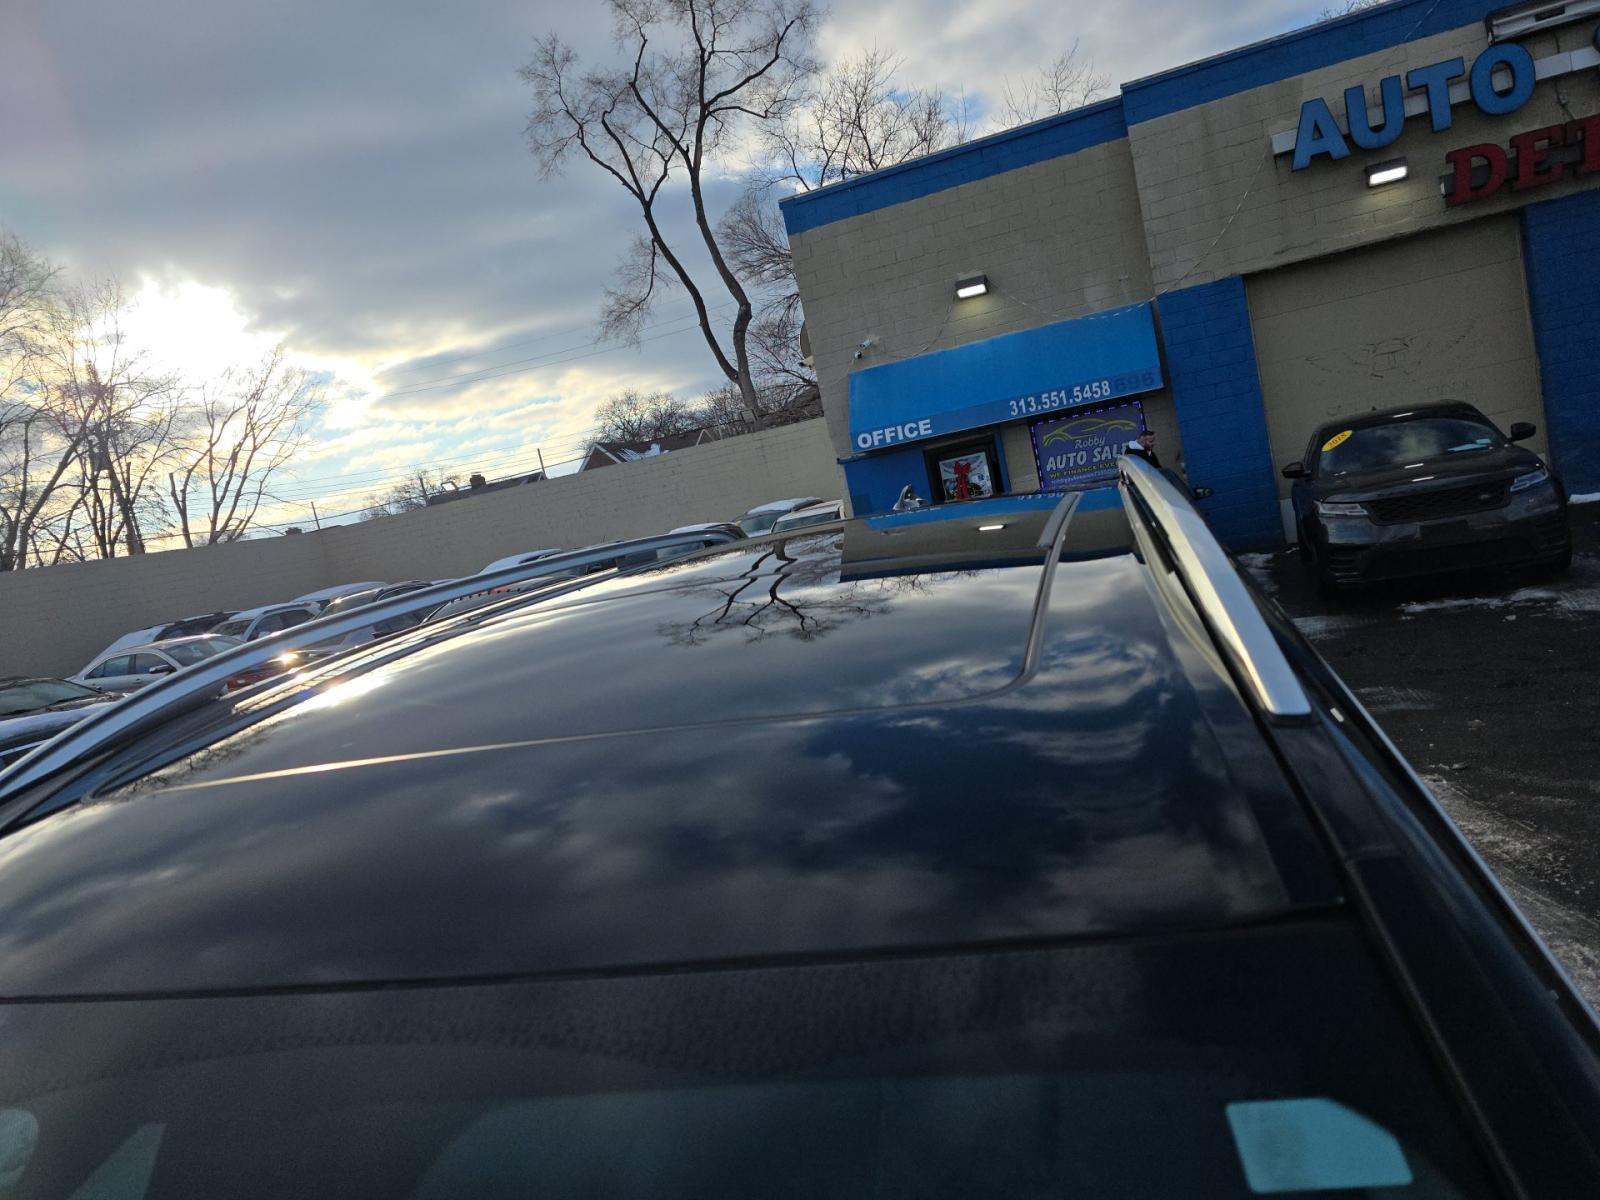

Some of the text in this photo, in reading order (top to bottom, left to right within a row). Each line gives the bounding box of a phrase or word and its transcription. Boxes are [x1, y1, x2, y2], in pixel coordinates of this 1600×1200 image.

[1290, 43, 1536, 172] AUTO
[1009, 380, 1111, 416] 313.551.5458
[857, 418, 933, 448] OFFICE
[1074, 435, 1105, 449] Robby
[1046, 450, 1087, 471] AUTO
